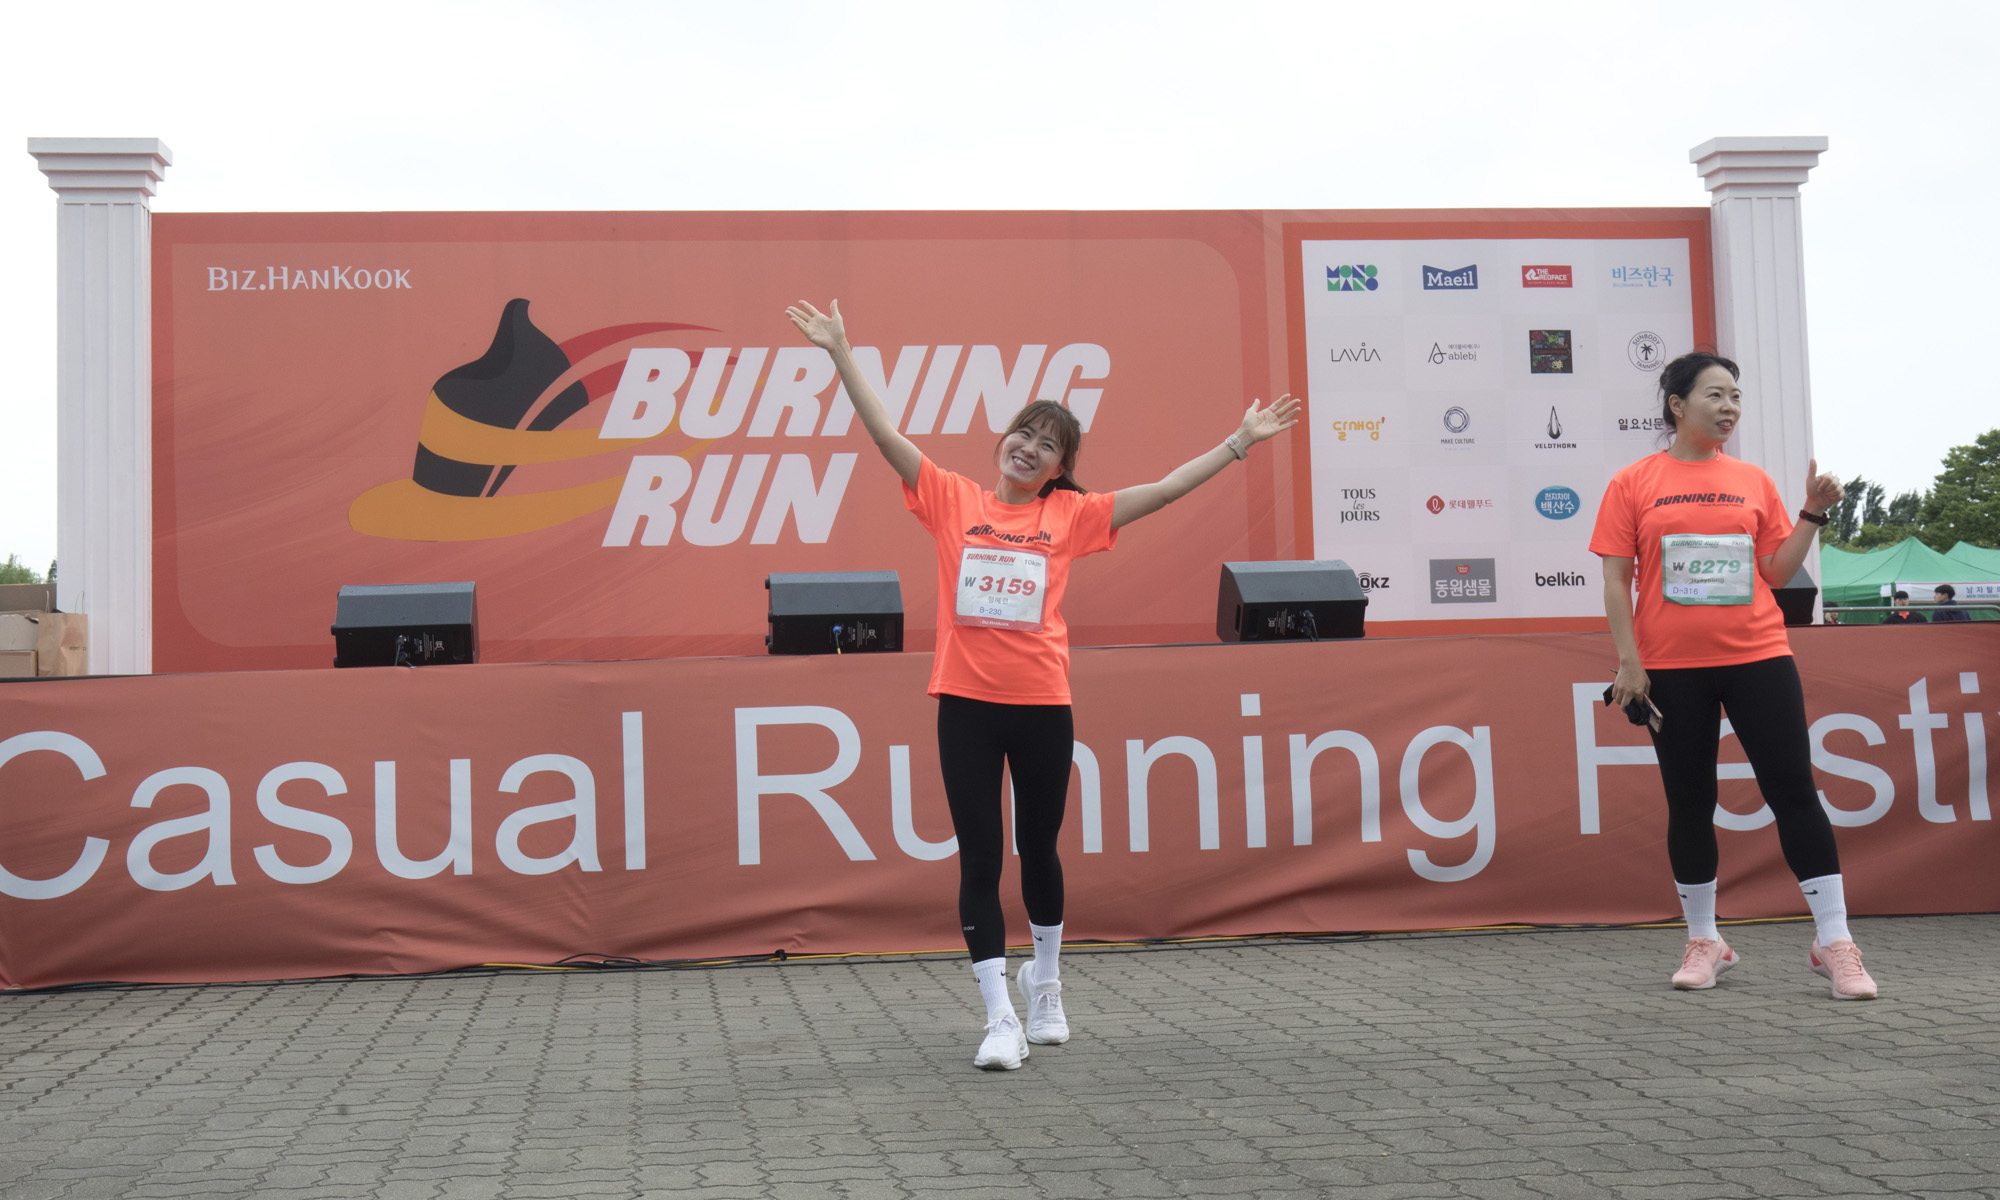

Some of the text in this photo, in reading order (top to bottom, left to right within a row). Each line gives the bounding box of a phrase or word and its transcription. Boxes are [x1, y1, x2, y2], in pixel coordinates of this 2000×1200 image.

[1427, 271, 1474, 287] Maeil
[1611, 266, 1674, 288] 비즈한국
[1632, 333, 1661, 346] SUNBODY
[1448, 351, 1477, 362] ablebj
[1636, 360, 1660, 370] TANNING
[598, 343, 1110, 439] BURNING
[1618, 418, 1665, 430] 일요신문
[602, 452, 858, 547] RUN
[1341, 489, 1376, 500] TOUS
[1544, 492, 1570, 500] 천지차이
[1654, 493, 1745, 508] BURNING RUN
[1353, 499, 1365, 510] les
[1449, 500, 1493, 509] 롯데웰푸드
[1541, 501, 1575, 514] 백산수
[1340, 510, 1380, 524] JOURS
[966, 553, 997, 561] BURNING
[1672, 560, 1741, 574] W 8279
[964, 575, 1036, 596] W 3159
[1357, 577, 1390, 589] OKZ
[1535, 572, 1585, 587] belkin
[1435, 578, 1492, 598] 동원샘물
[1673, 587, 1698, 595] D-316
[0, 711, 646, 900] Casual
